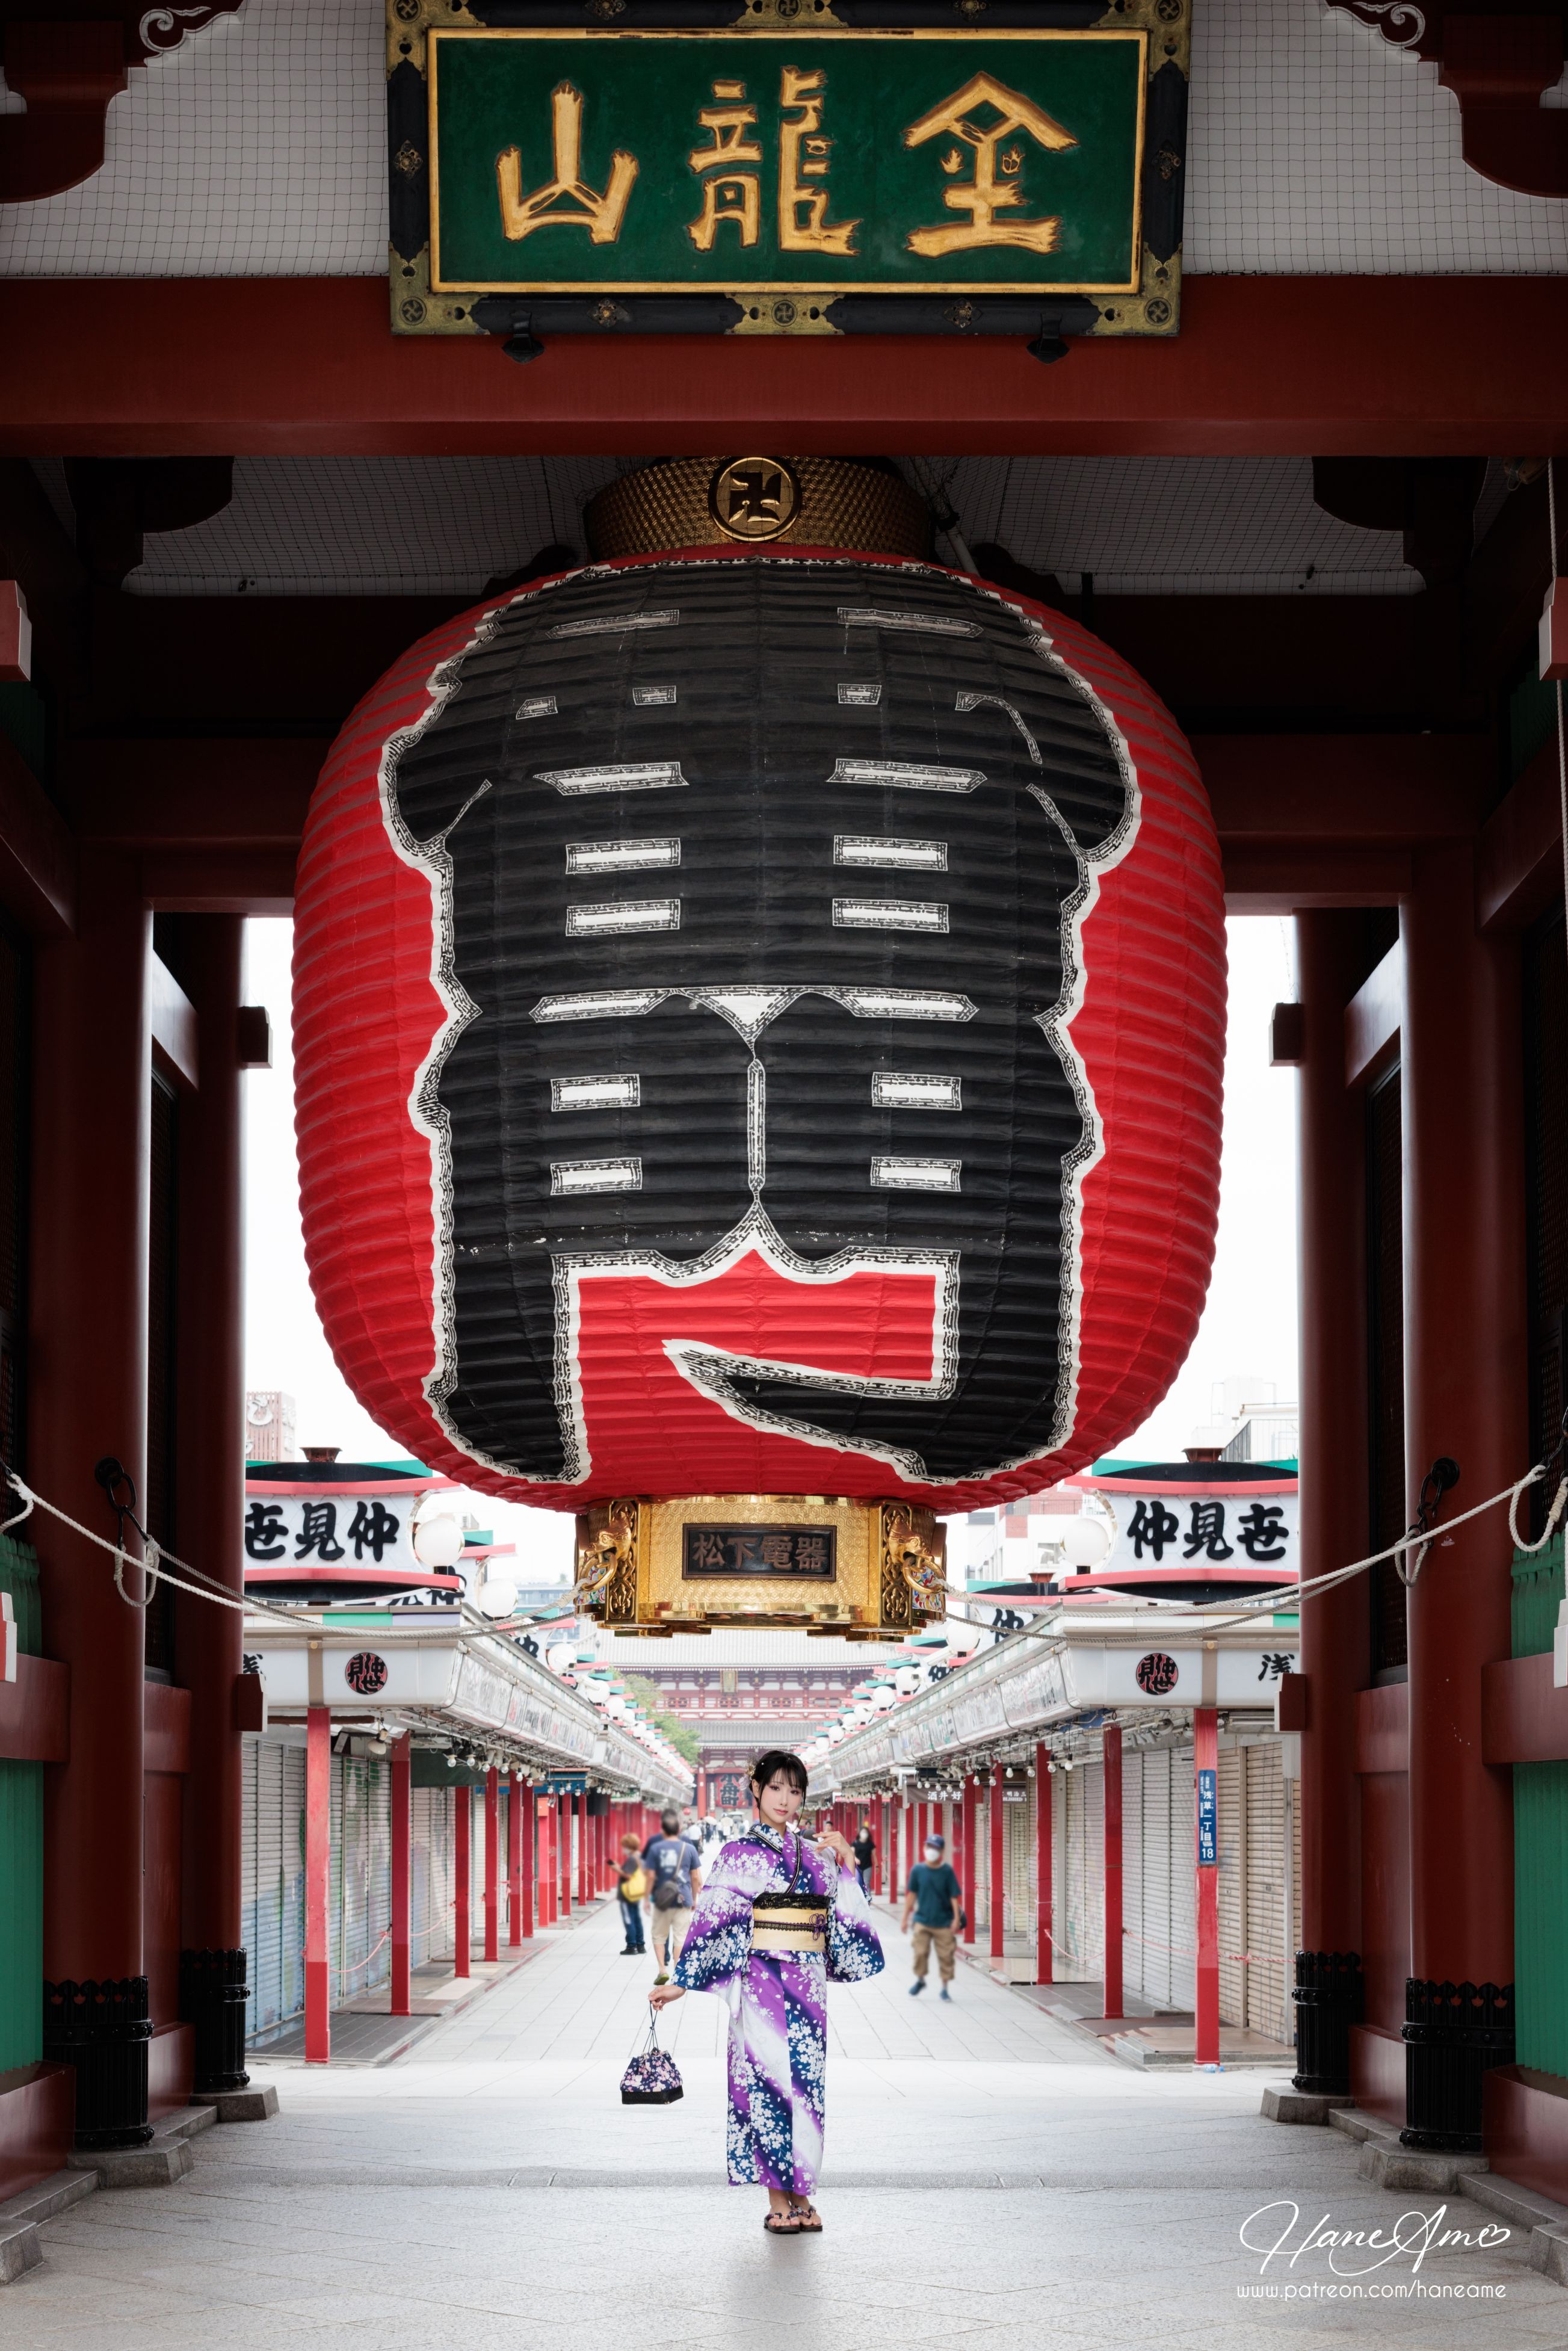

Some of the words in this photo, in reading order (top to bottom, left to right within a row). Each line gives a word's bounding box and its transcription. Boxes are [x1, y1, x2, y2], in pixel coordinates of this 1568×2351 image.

[693, 1533, 827, 1571] 松下電器
[1127, 1500, 1289, 1561] 仲見世
[1203, 1791, 1212, 1841] 浅草一丁目
[1202, 1848, 1214, 1859] 18
